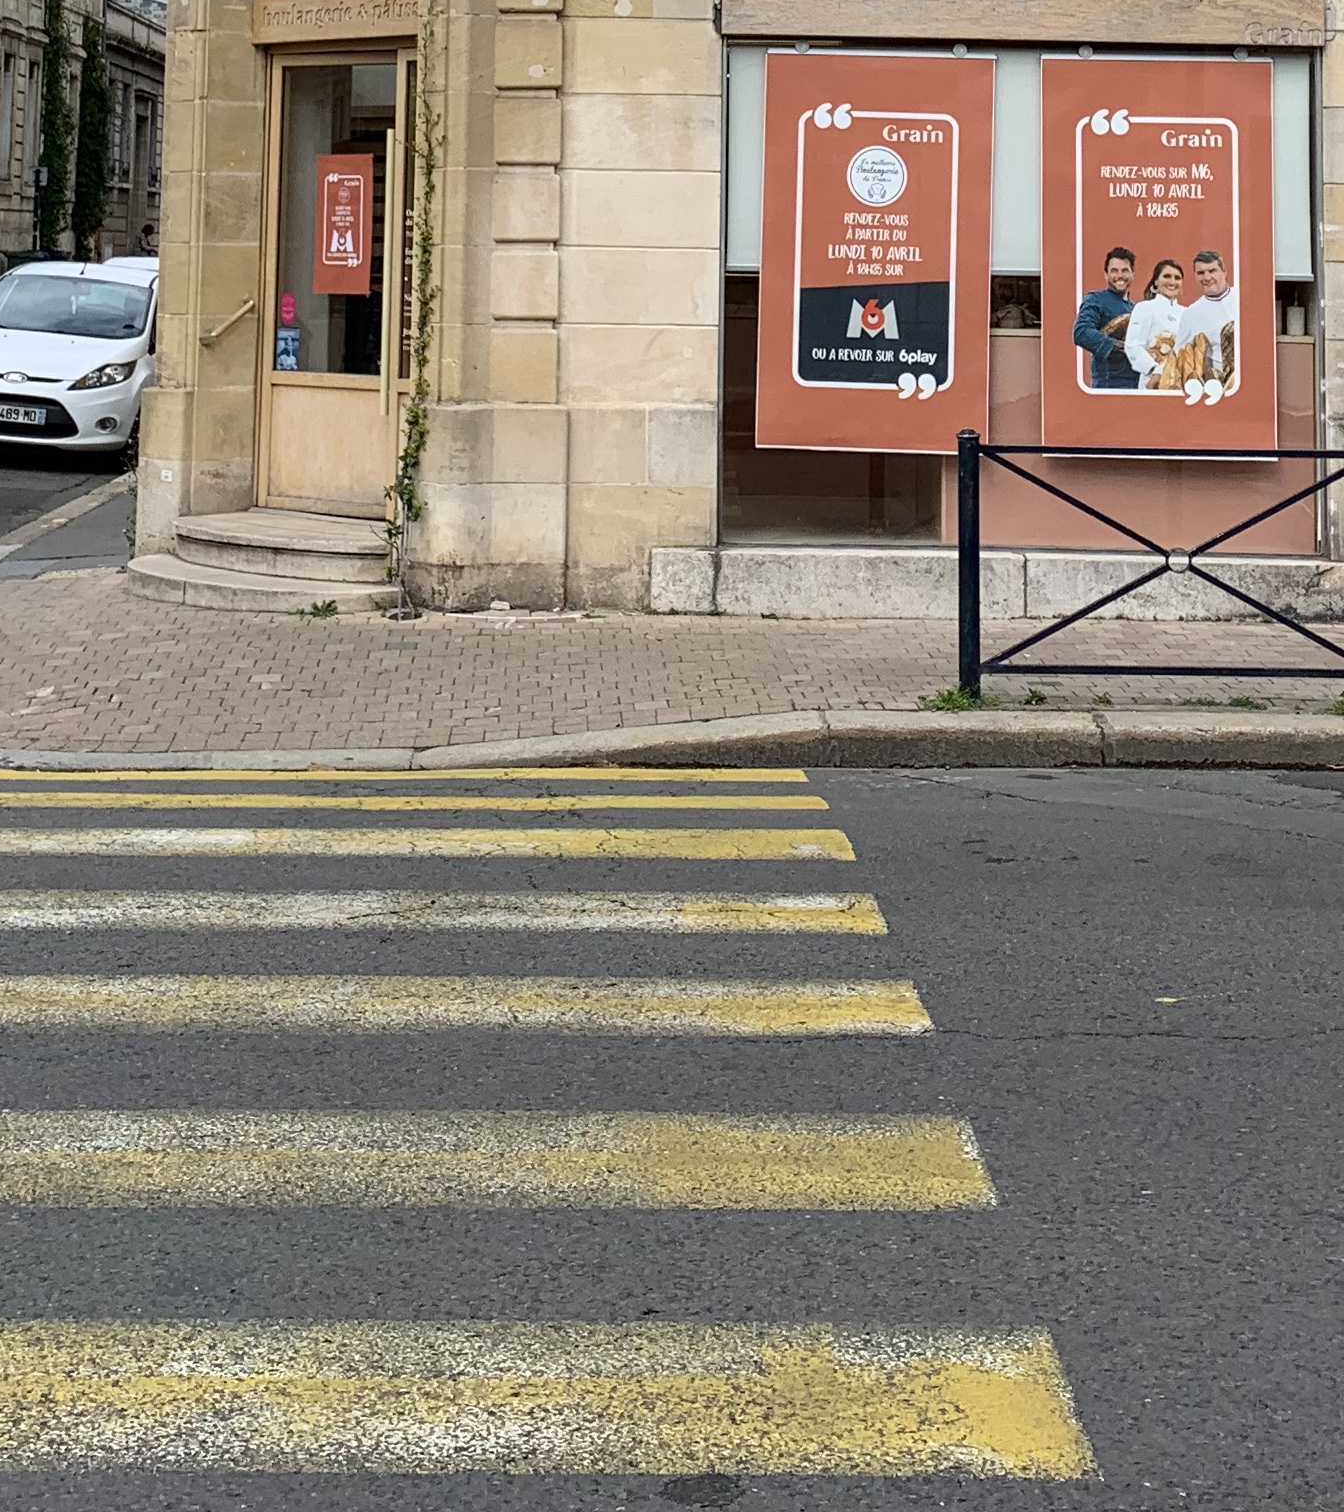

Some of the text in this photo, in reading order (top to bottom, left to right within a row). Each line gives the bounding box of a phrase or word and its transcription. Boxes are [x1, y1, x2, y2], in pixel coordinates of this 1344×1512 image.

[263, 1, 353, 29] boulangerie
[357, 3, 368, 20] &
[1245, 21, 1323, 45] Grain
[882, 124, 943, 143] Grain
[1161, 129, 1223, 147] Grain
[1101, 163, 1214, 181] RENDEZ-VOUS SUR M6,
[1109, 183, 1205, 199] LUNDI 10 AVRIL
[1136, 202, 1179, 217] À 18H35
[844, 212, 909, 226] RENDEZ-VOUS
[845, 225, 907, 241] À PARTIR DU
[828, 244, 923, 262] LUNDI 10 AVRIL
[846, 259, 854, 275] À
[885, 263, 904, 276] SUR
[812, 348, 937, 365] OU A REVOIR SUR 6play
